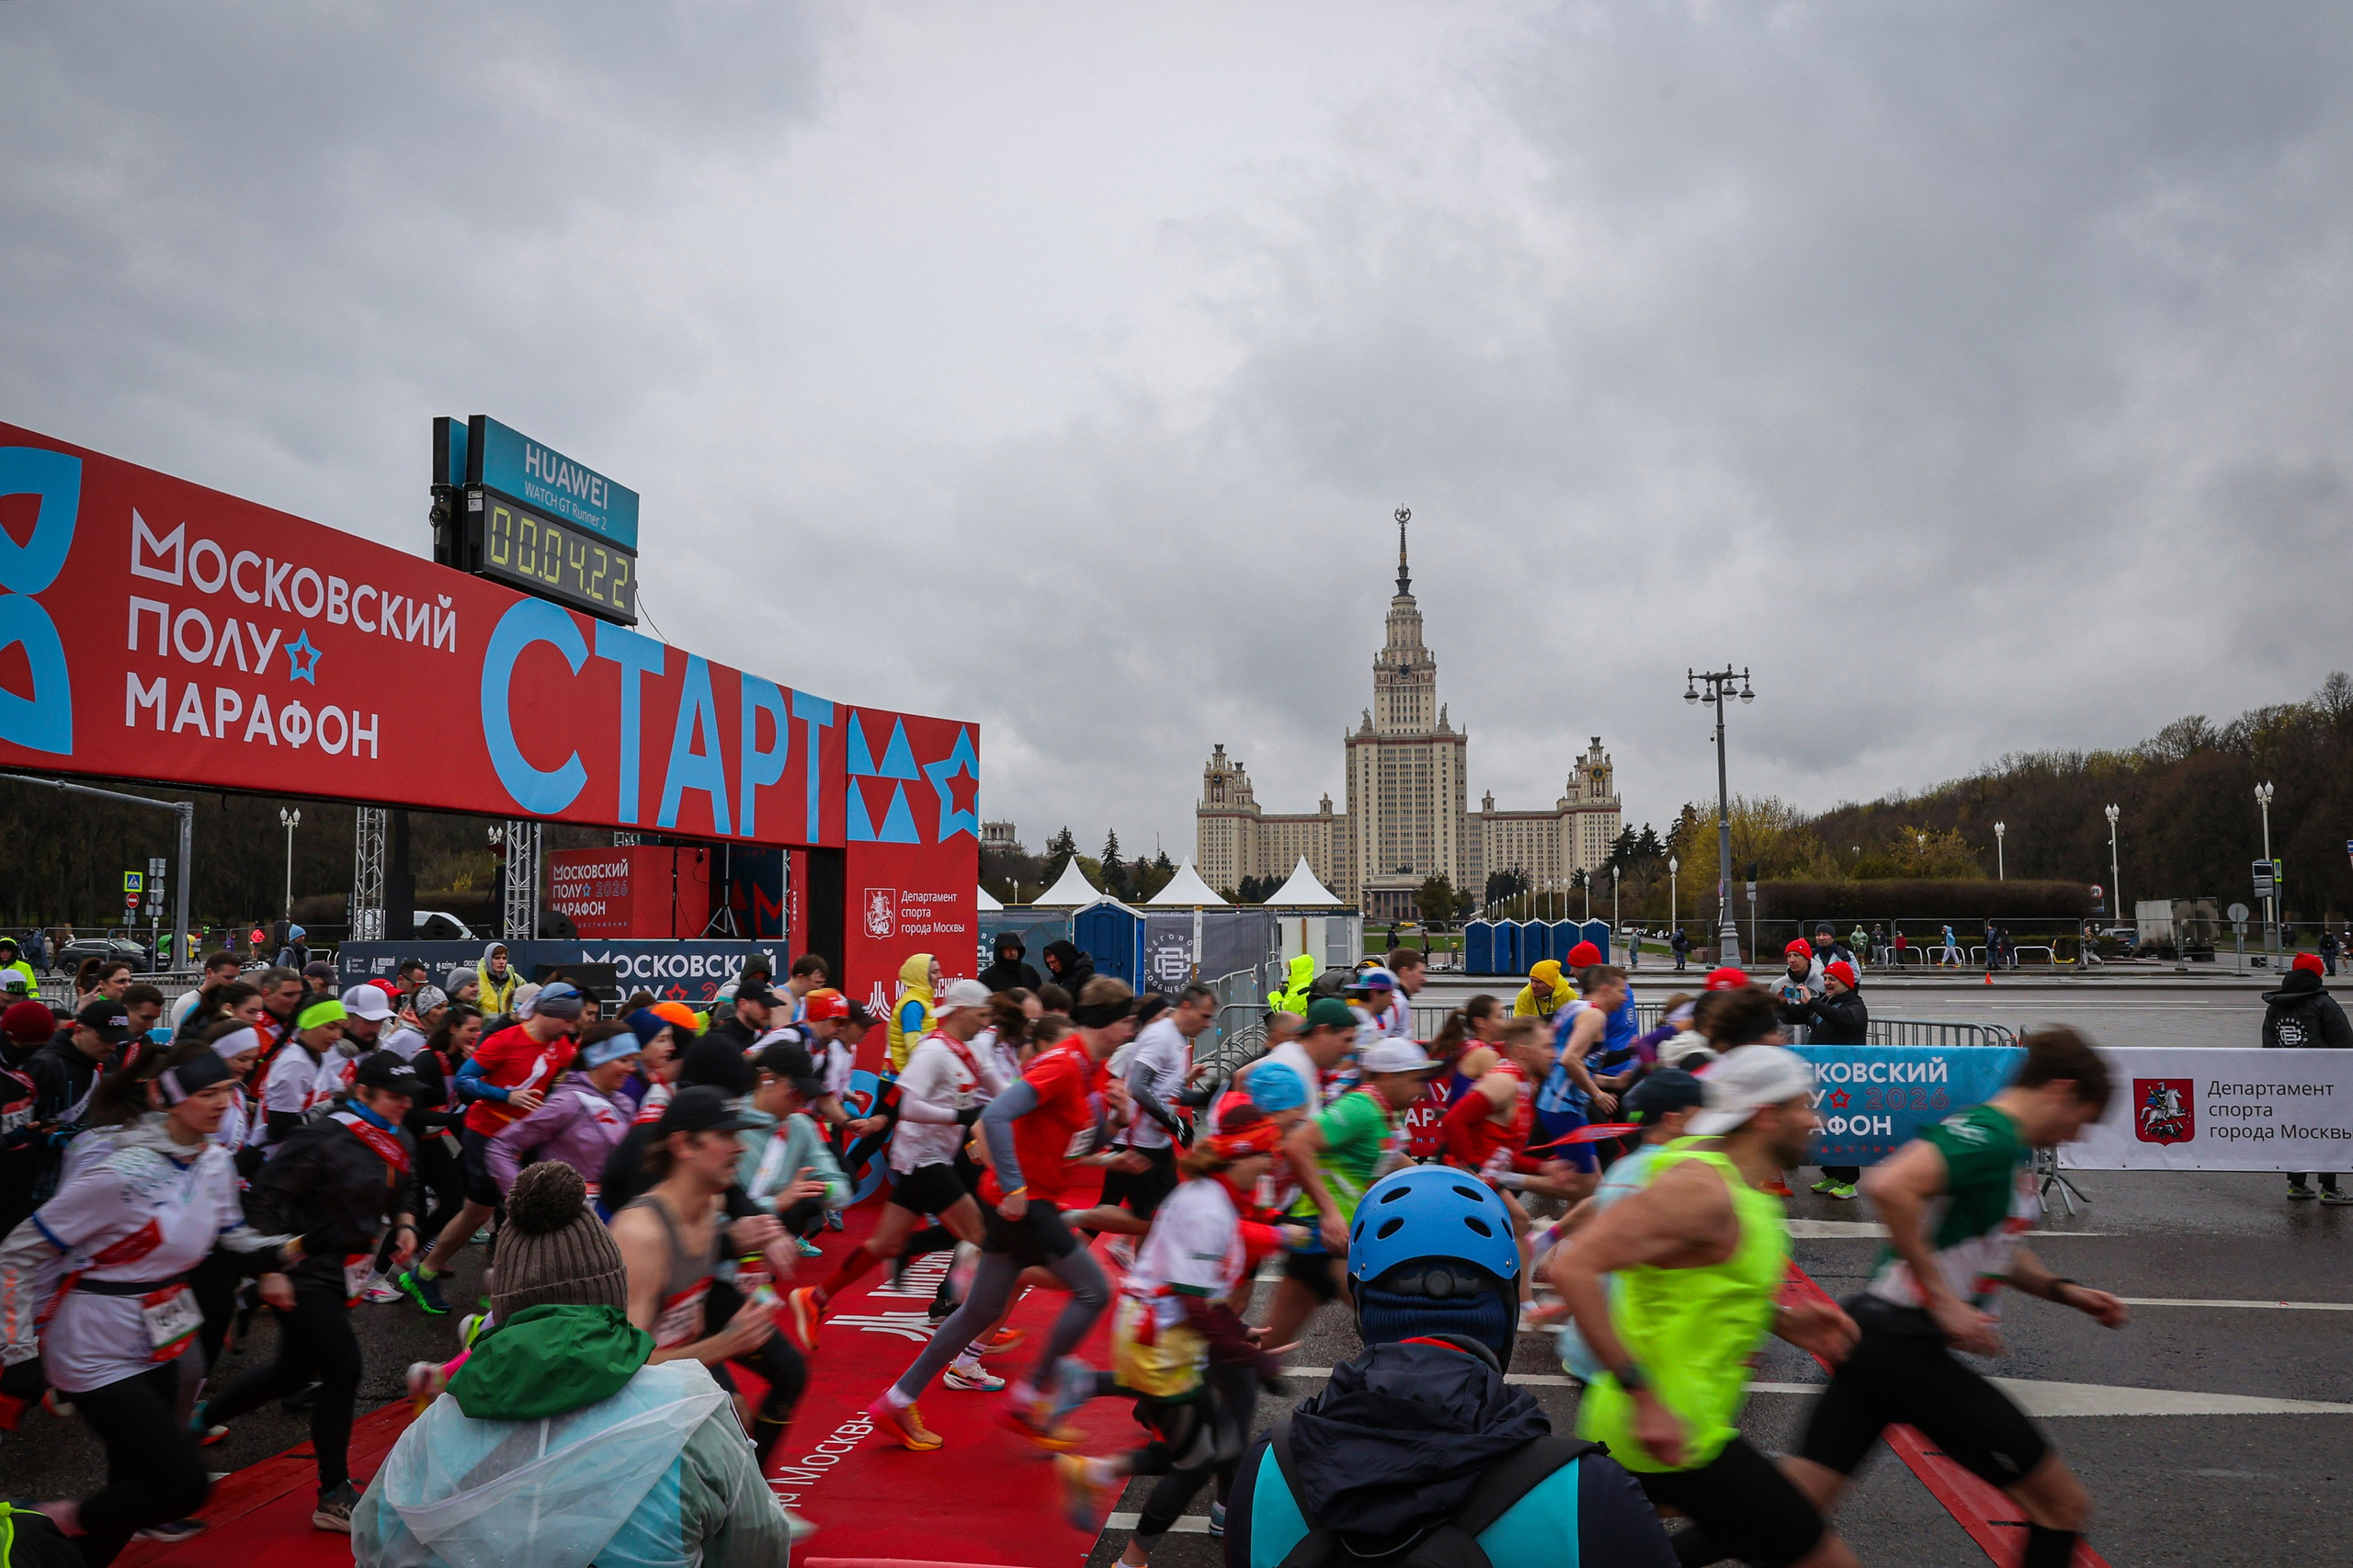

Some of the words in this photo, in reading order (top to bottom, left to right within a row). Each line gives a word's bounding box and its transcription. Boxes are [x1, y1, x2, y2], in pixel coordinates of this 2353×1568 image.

[525, 443, 608, 510] HUAWEI
[525, 481, 558, 508] WATCH
[559, 497, 571, 513] GT
[573, 506, 599, 528] Runner
[601, 517, 607, 530] 2
[131, 506, 456, 653] МОСКОВСКИЙ
[128, 596, 281, 676] ПОЛУ
[126, 672, 379, 759] МАРАФОН
[481, 597, 834, 844] СТАРТ
[553, 858, 629, 881] МОСКОВСКИЙ
[552, 884, 583, 899] ПОЛУ
[596, 880, 629, 898] 2026
[901, 891, 958, 903] Департамент
[552, 901, 606, 916] МАРАФОН
[901, 909, 931, 919] спорта
[901, 925, 932, 936] города
[933, 923, 965, 933] Москвы
[1146, 934, 1193, 953] БЕГОВО
[583, 949, 777, 978] ОСКОВСКЙ
[1805, 1057, 1948, 1083] КОВСКИЙ
[1865, 1087, 1949, 1110] 2026
[2208, 1081, 2334, 1099] Департамент
[2209, 1105, 2273, 1120] спорта
[1808, 1115, 1892, 1136] АФОН
[2211, 1126, 2274, 1142] города
